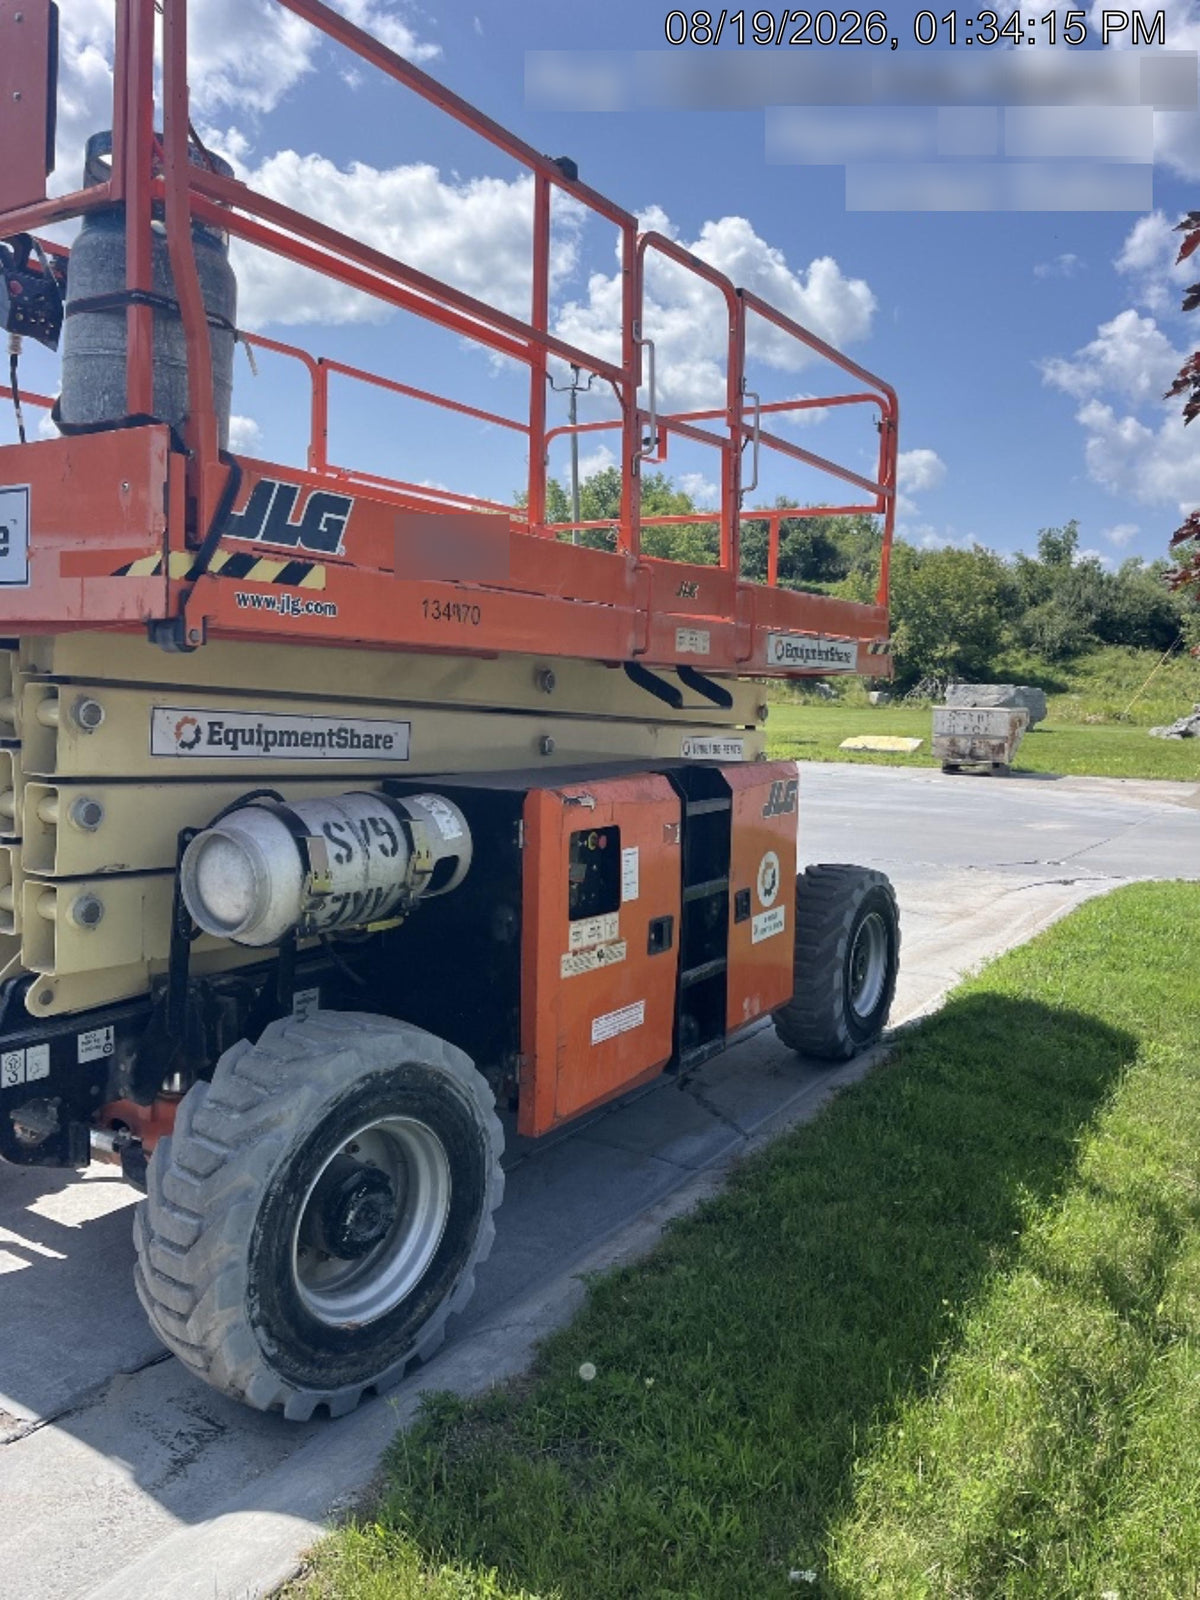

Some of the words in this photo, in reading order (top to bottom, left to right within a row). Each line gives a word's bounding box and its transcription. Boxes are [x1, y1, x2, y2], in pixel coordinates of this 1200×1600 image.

[220, 477, 355, 556] JLG
[234, 591, 337, 617] www.jlg.com
[207, 721, 394, 752] EquipmentShare
[761, 778, 798, 819] JLG
